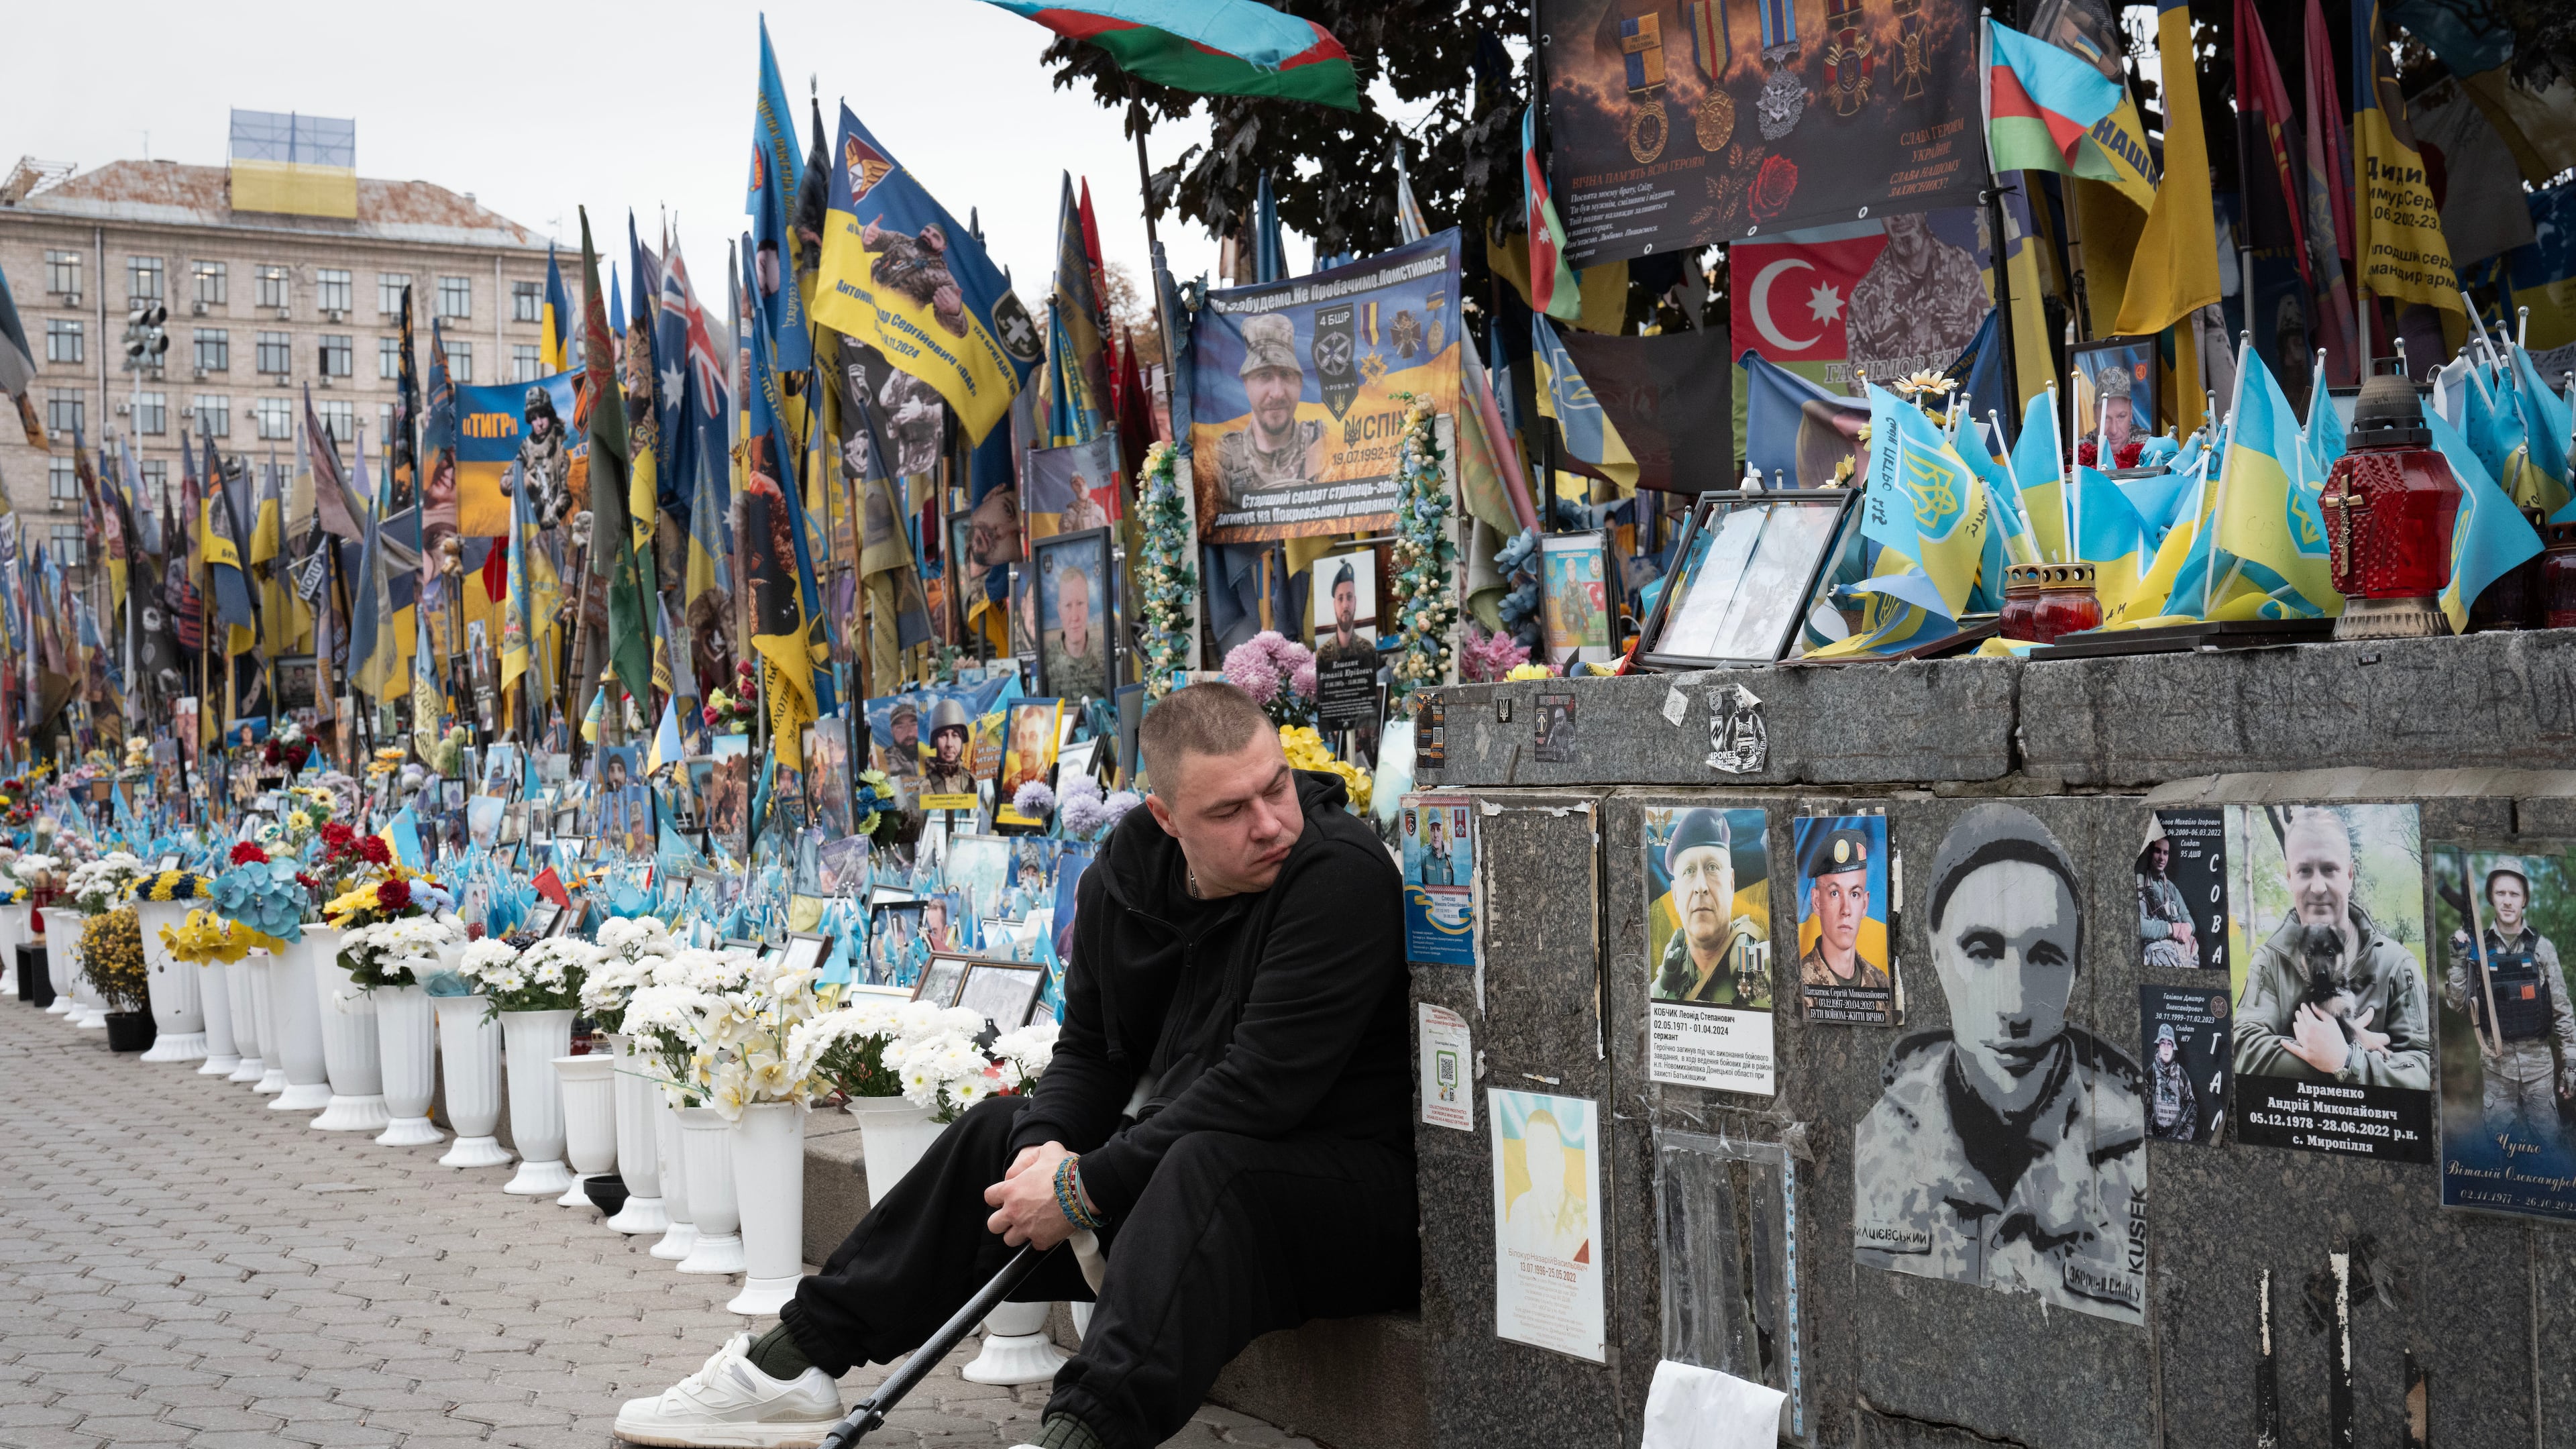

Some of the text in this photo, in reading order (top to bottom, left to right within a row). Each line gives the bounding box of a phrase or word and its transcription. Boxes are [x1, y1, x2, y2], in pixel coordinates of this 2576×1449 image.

[1900, 117, 1964, 146] СЛАВА ГЕРОЯМ
[1912, 141, 1951, 162] УКРАЇНИ!
[1572, 177, 1603, 189] ВІЧНА
[1648, 162, 1668, 177] ВСІМ
[1670, 156, 1706, 170] ГЕРОЯМ
[1890, 159, 1962, 184] СЛАВА НАШОМУ
[1888, 177, 1949, 197] ЗАХИСНИКУ!
[1320, 311, 1350, 327] 4 БШР
[985, 340, 1010, 379] БРИГАДА
[1329, 383, 1350, 391] РУБІЖ
[1242, 488, 1326, 510] Старший солдат
[1256, 511, 1271, 523] на
[1272, 502, 1346, 523] Покровському
[1346, 497, 1398, 516] напрямку
[2198, 818, 2220, 826] Ігорович
[1805, 986, 1888, 999] Патлатюк Сергій Миколайович
[2184, 994, 2204, 1003] Дмитро
[1654, 1008, 1735, 1023] КОБЧИК Леонід Степанович
[1811, 1009, 1825, 1018] БУТИ
[1866, 1012, 1884, 1022] ВІЧНО
[2155, 1012, 2215, 1024] 30.11.1999-11.02.2023
[2166, 1005, 2203, 1013] Олександрович
[1654, 1020, 1688, 1032] 02.05.1971
[1693, 1024, 1729, 1036] 01.04.2024
[1654, 1032, 1678, 1042] сержант
[2176, 1024, 2195, 1033] Солдат
[1654, 1043, 1676, 1053] Героїчно
[1676, 1046, 1697, 1055] загинув
[1697, 1047, 1705, 1056] під
[1717, 1051, 1744, 1059] виконання
[1745, 1052, 1769, 1062] бойового
[1654, 1053, 1679, 1061] завдання,
[1686, 1056, 1697, 1064] ході
[1719, 1059, 1741, 1068] бойових
[1742, 1061, 1751, 1069] дій
[1756, 1064, 1773, 1072] районі
[1664, 1063, 1705, 1073] Новомихайлівка
[1706, 1067, 1733, 1077] Донецької
[1754, 1073, 1764, 1081] при
[1654, 1070, 1707, 1082] захисті Батьківщини.
[2297, 1082, 2365, 1099] Авраменко
[2267, 1096, 2398, 1120] Андрій Миколайович
[2249, 1112, 2314, 1129] 05.12.1978
[2394, 1129, 2419, 1142] р.н.
[2292, 1134, 2373, 1153] с. Миропілля
[2495, 1132, 2542, 1159] Чуйко
[2445, 1159, 2501, 1179] Віталій
[2460, 1189, 2512, 1205] 02.11.1977
[2127, 1185, 2147, 1276] KUSEK
[1509, 1248, 1588, 1272] Білокур Назарій Васильович
[1520, 1262, 1576, 1283] 13.07.1996-25.05.2022
